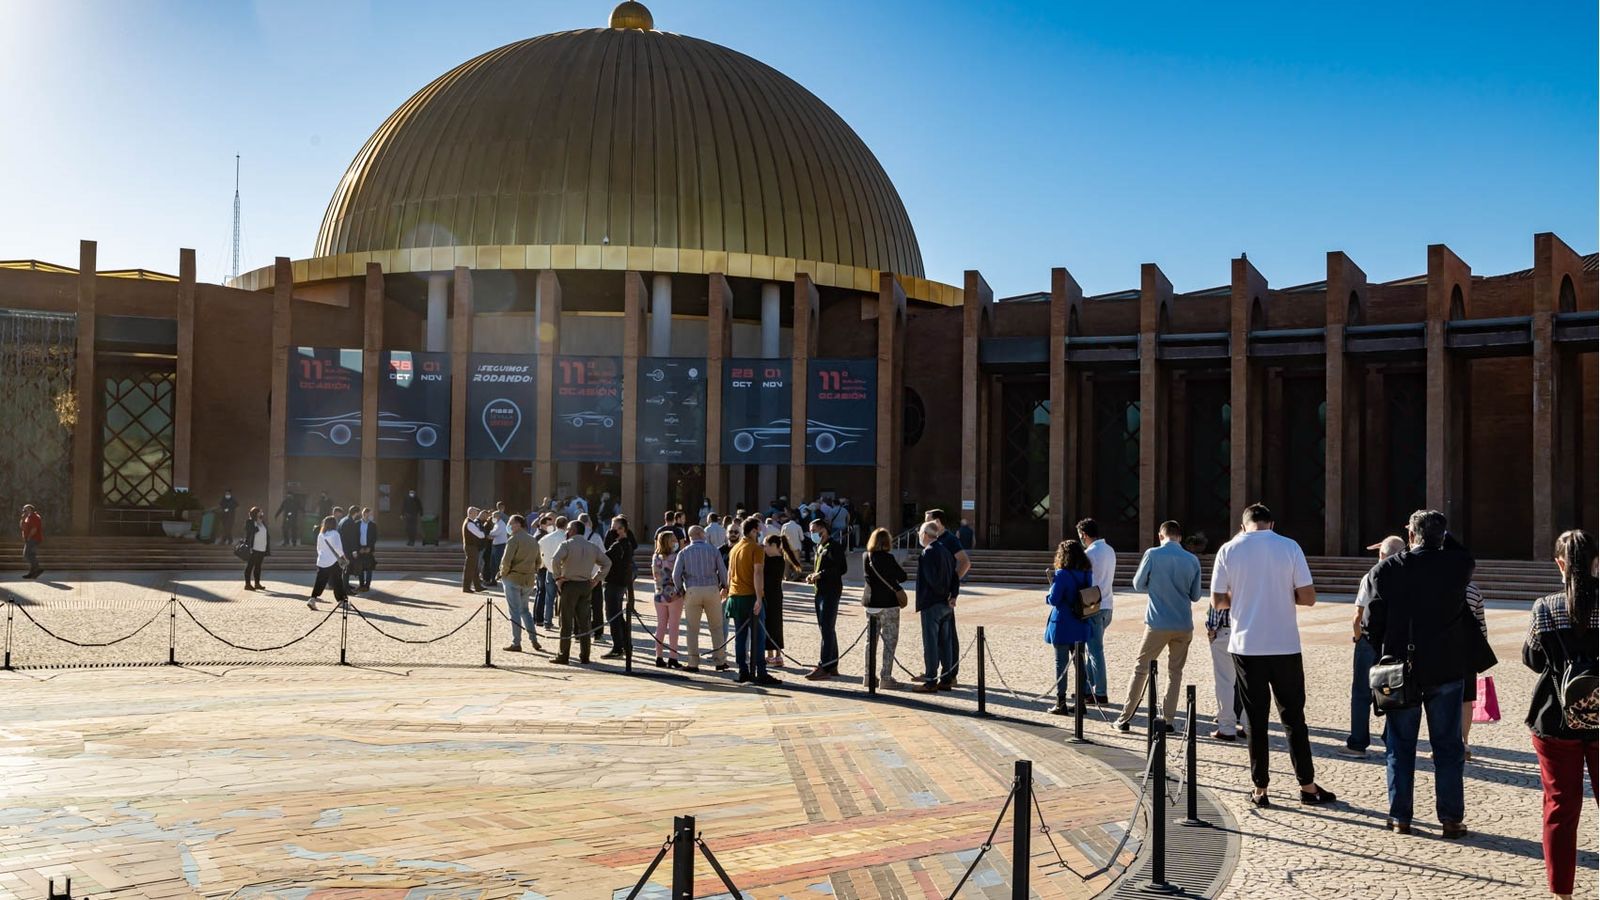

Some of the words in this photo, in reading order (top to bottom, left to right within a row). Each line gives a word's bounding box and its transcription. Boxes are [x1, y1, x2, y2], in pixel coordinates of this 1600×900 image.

[389, 360, 412, 371] 28
[472, 373, 534, 383] RODANDO!
[732, 368, 753, 378] 28
